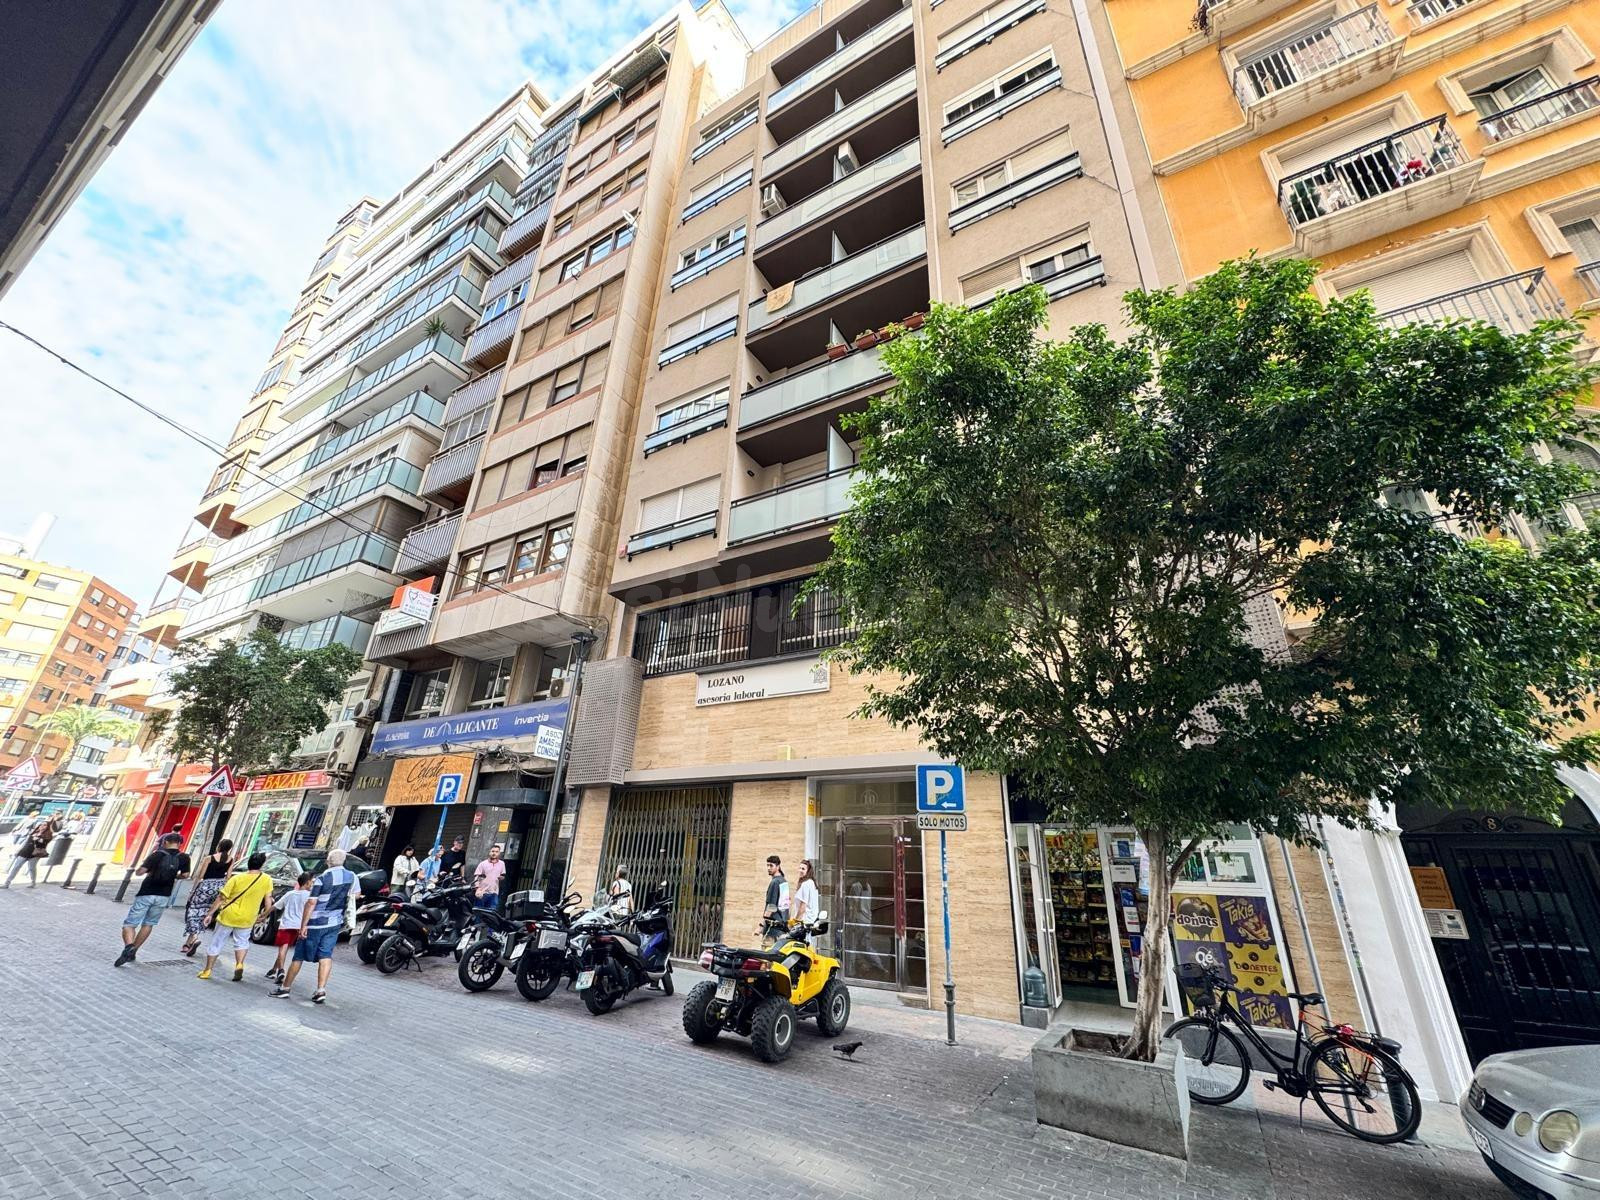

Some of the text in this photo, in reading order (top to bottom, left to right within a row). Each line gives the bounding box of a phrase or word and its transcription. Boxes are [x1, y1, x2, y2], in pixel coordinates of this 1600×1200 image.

[707, 675, 745, 689] LOZANO
[734, 689, 765, 701] laboral
[453, 718, 500, 735] ALICANTE
[407, 756, 448, 783] Celeste
[263, 772, 307, 790] BAZAR
[926, 769, 954, 805] P
[939, 817, 964, 828] MOTOS
[1487, 818, 1497, 830] 8
[1177, 914, 1219, 928] donuts
